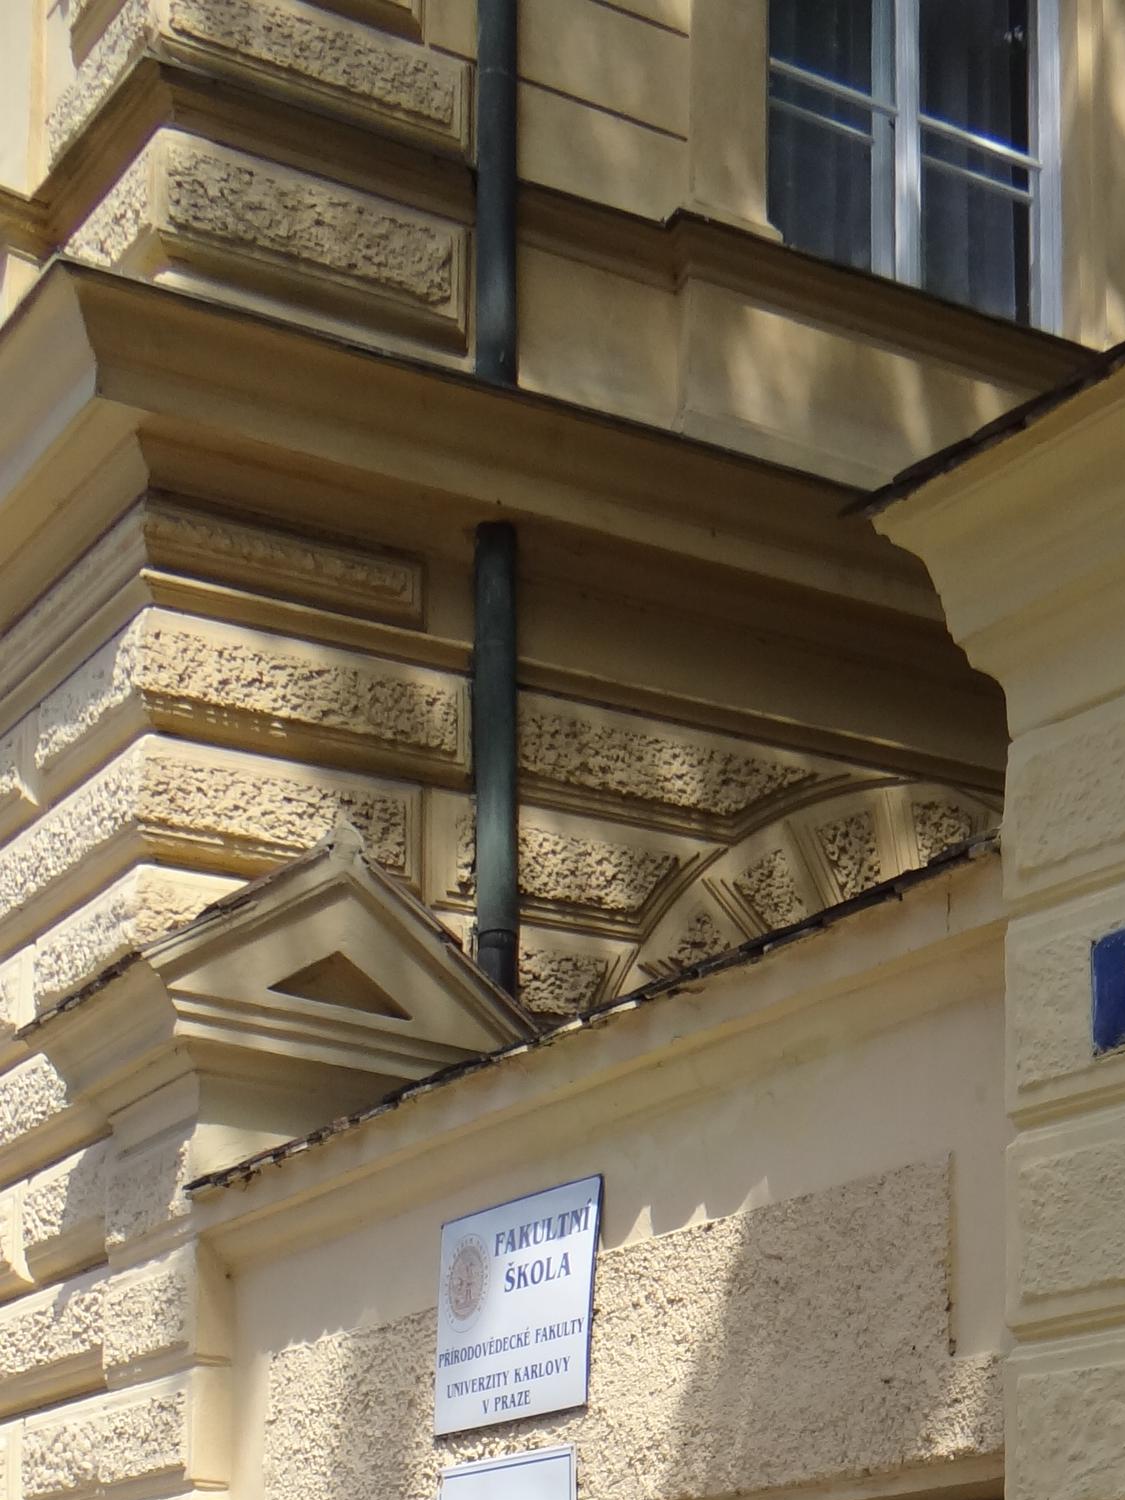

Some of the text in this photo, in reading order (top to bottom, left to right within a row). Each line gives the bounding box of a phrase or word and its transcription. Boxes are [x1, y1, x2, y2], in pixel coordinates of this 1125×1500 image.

[494, 1198, 592, 1257] FAKULTNÍ
[504, 1252, 571, 1293] ŠKOLA
[535, 1317, 585, 1344] FAKULTY
[447, 1355, 571, 1399] UNIVERZITY KARLOVY
[482, 1389, 531, 1415] V PRAZE
